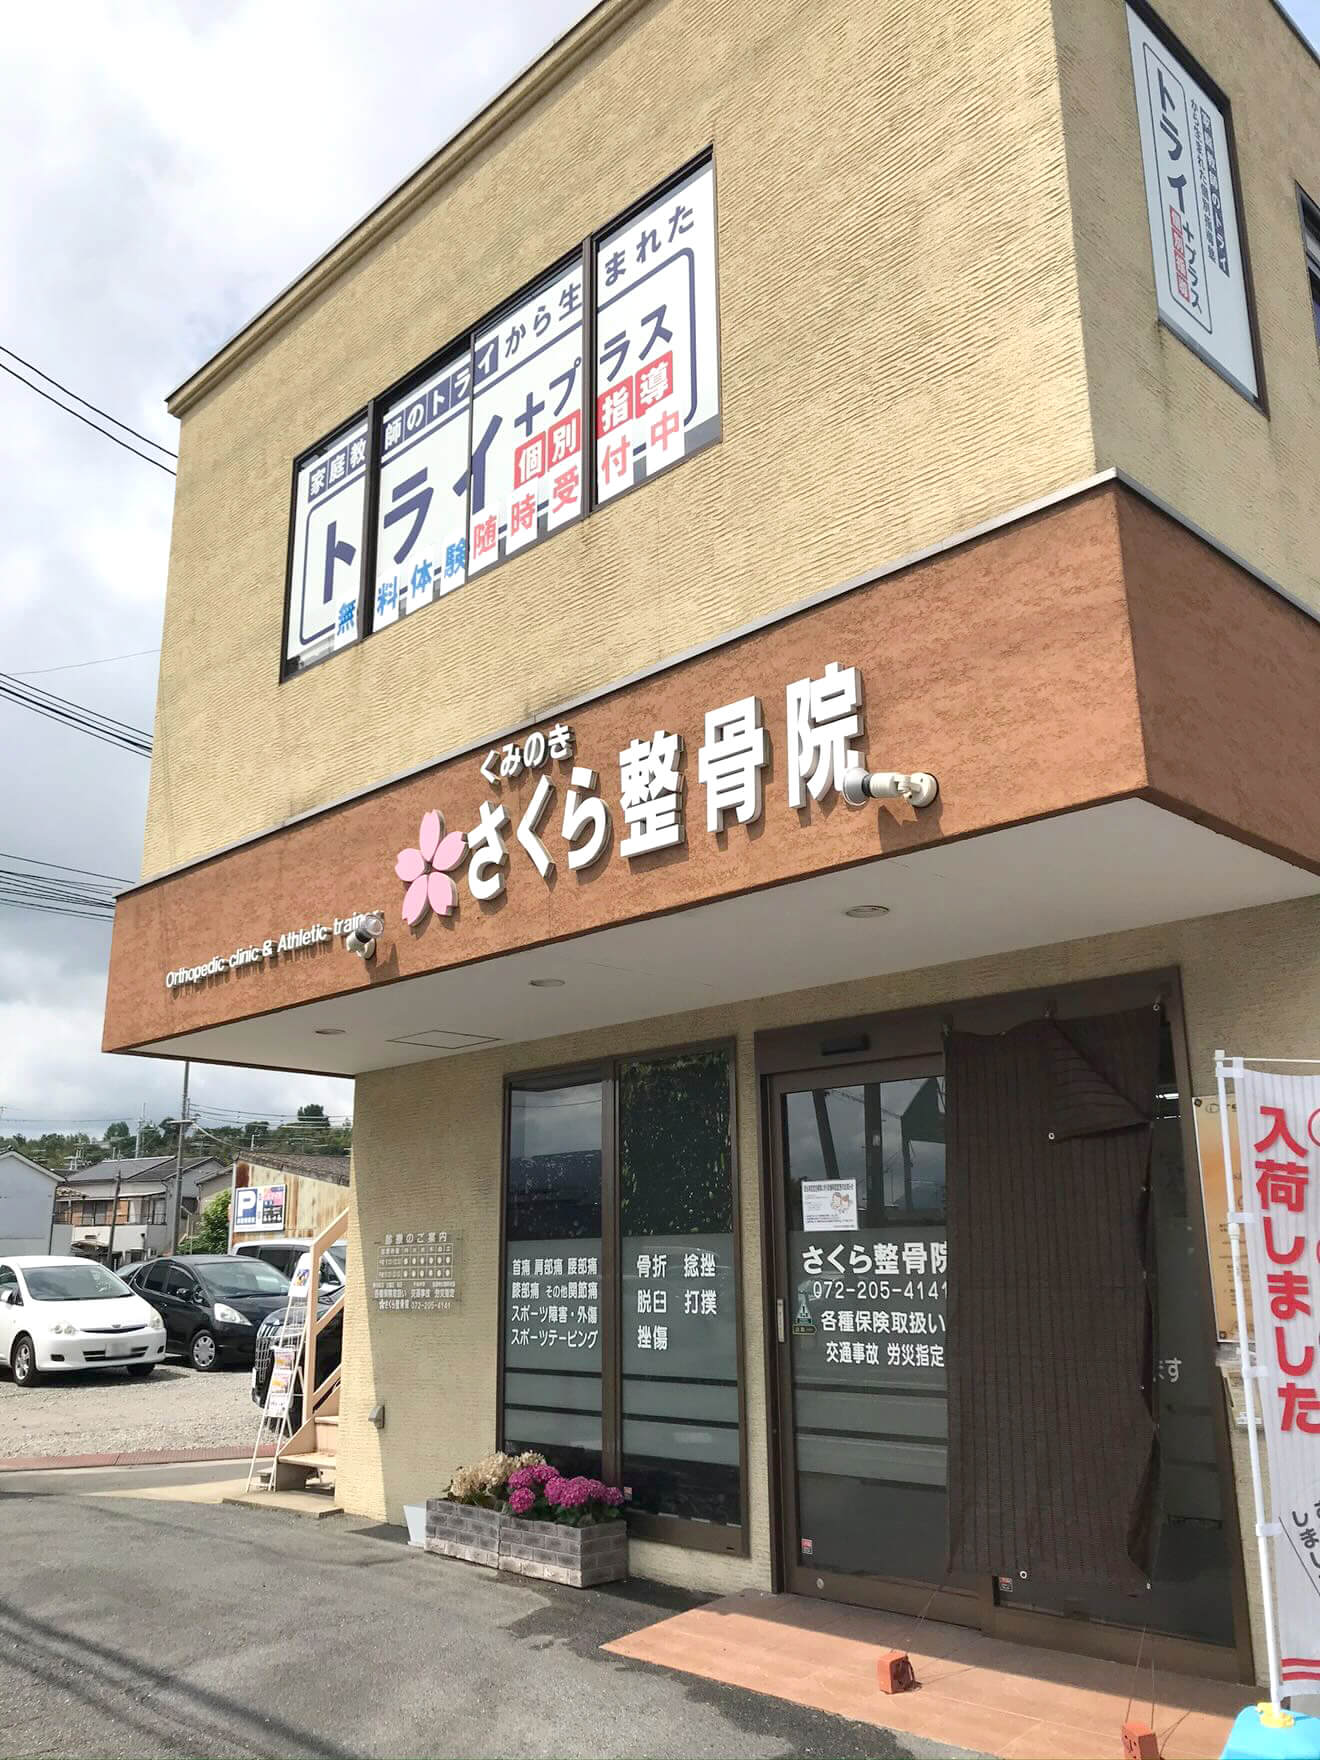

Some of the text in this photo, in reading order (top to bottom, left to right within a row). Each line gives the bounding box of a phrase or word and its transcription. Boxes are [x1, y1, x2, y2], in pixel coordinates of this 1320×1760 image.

[515, 359, 671, 487] 個別指導
[480, 723, 575, 785] くみのき
[467, 661, 864, 901] さくら整骨院
[166, 910, 384, 988] Orthopedic clinic & Athletic train
[237, 1190, 256, 1217] P
[512, 1256, 598, 1276] 首痛 肩部痛 腰部痛
[636, 1253, 716, 1278] 骨折 捻挫
[802, 1240, 947, 1275] さくら整骨院
[1253, 1105, 1320, 1436] 入荷しました
[511, 1281, 598, 1300] 膝部痛 その他関節痛
[637, 1289, 717, 1315] 脱臼 打撲
[813, 1280, 947, 1300] 072-205-4141
[511, 1304, 598, 1324] スポーツ障害・外傷
[821, 1310, 946, 1334] 各種保険取扱い
[511, 1328, 598, 1349] スポーツテーピング
[637, 1325, 668, 1351] 挫傷
[826, 1341, 945, 1368] 交通事故 労災指定
[1291, 1510, 1320, 1580] しまし
